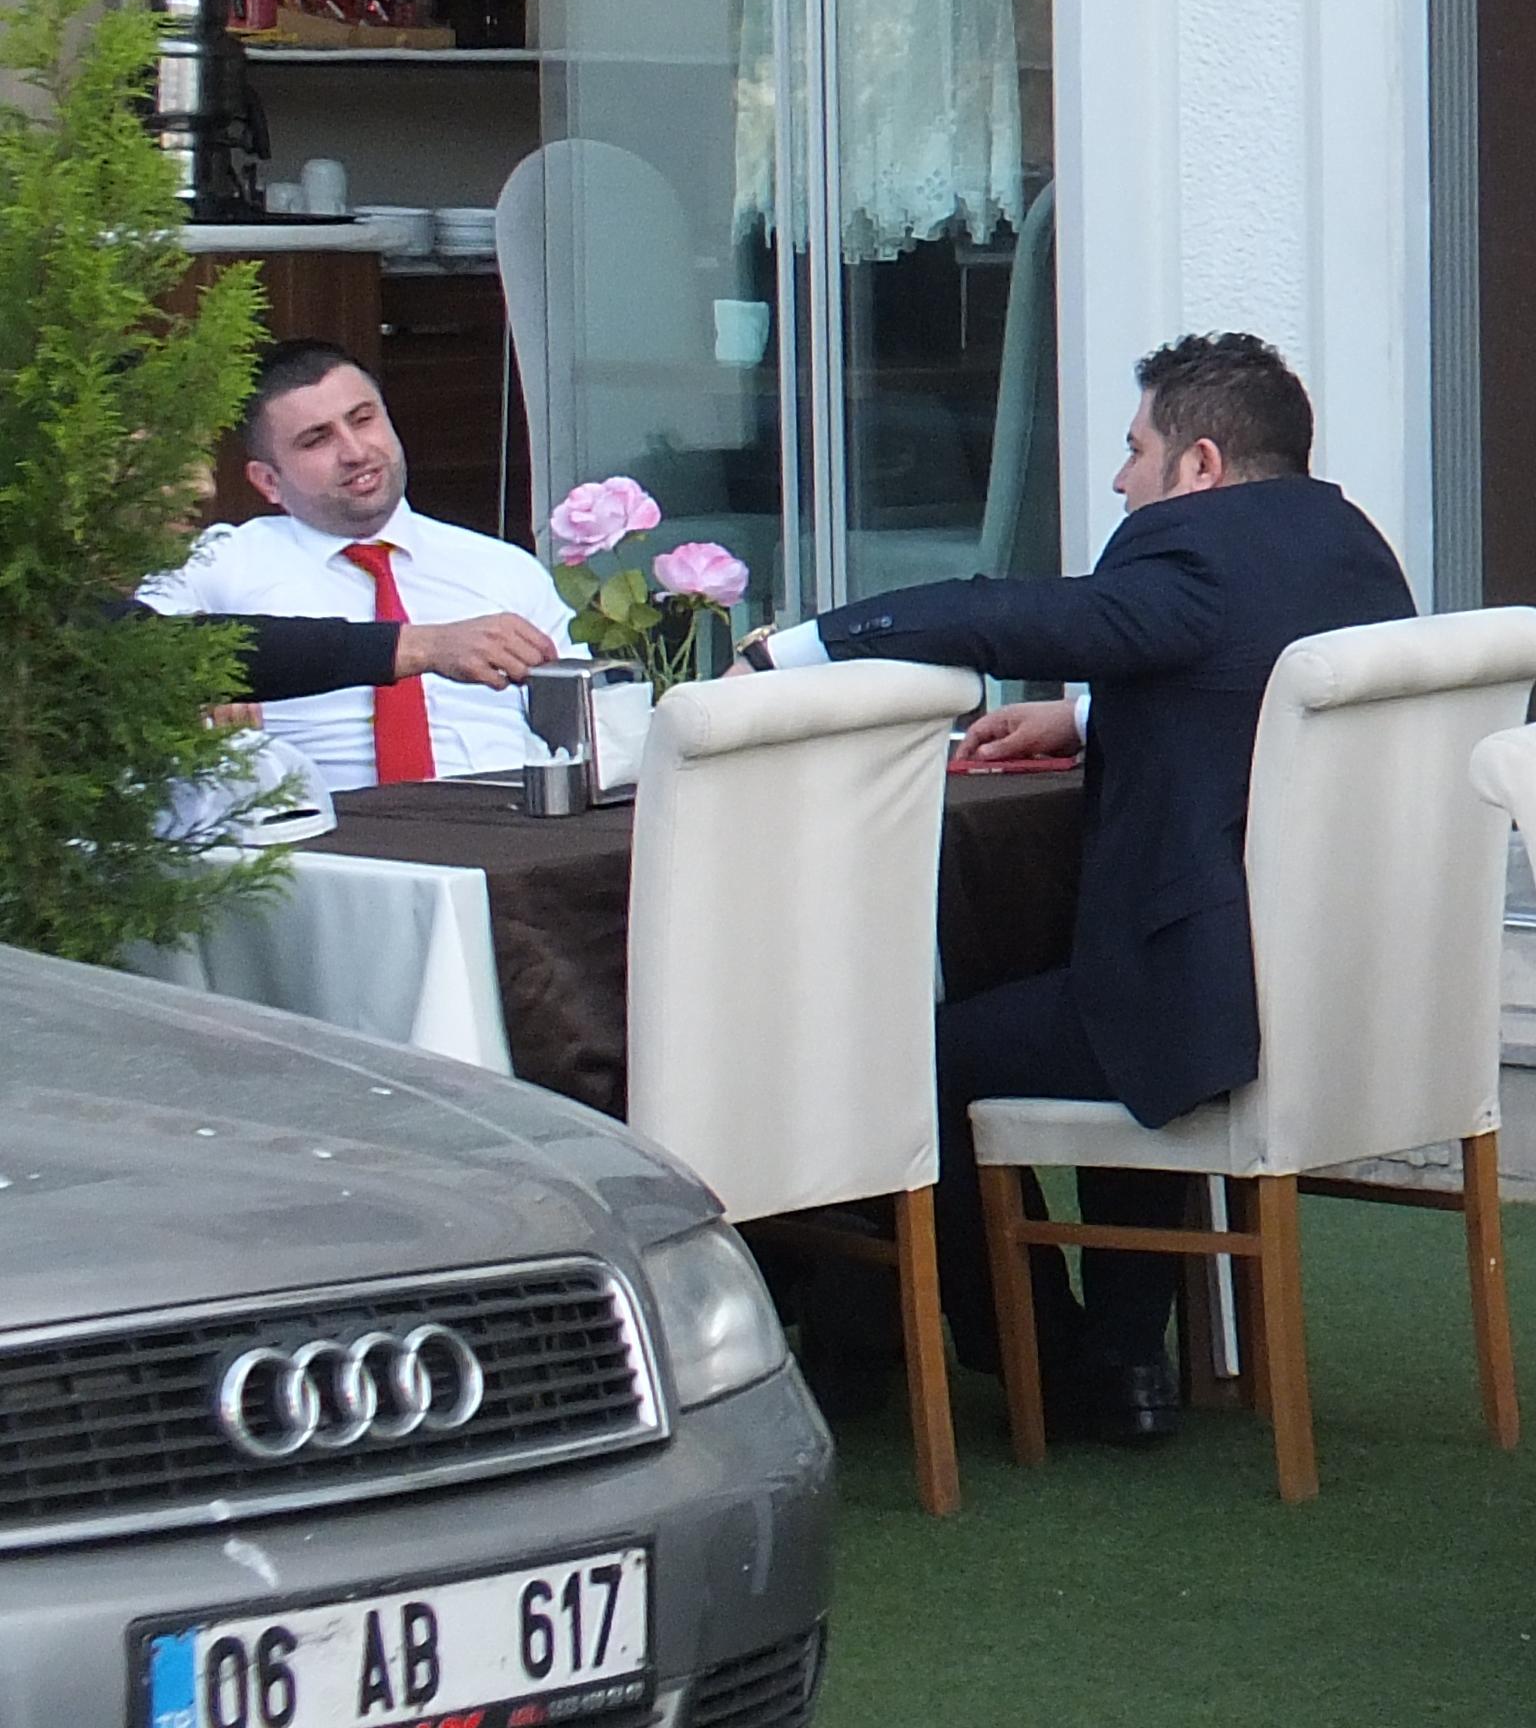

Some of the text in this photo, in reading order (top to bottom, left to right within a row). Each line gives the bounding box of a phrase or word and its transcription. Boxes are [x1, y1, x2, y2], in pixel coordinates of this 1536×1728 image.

[205, 1562, 623, 1728] 06 AB 617
